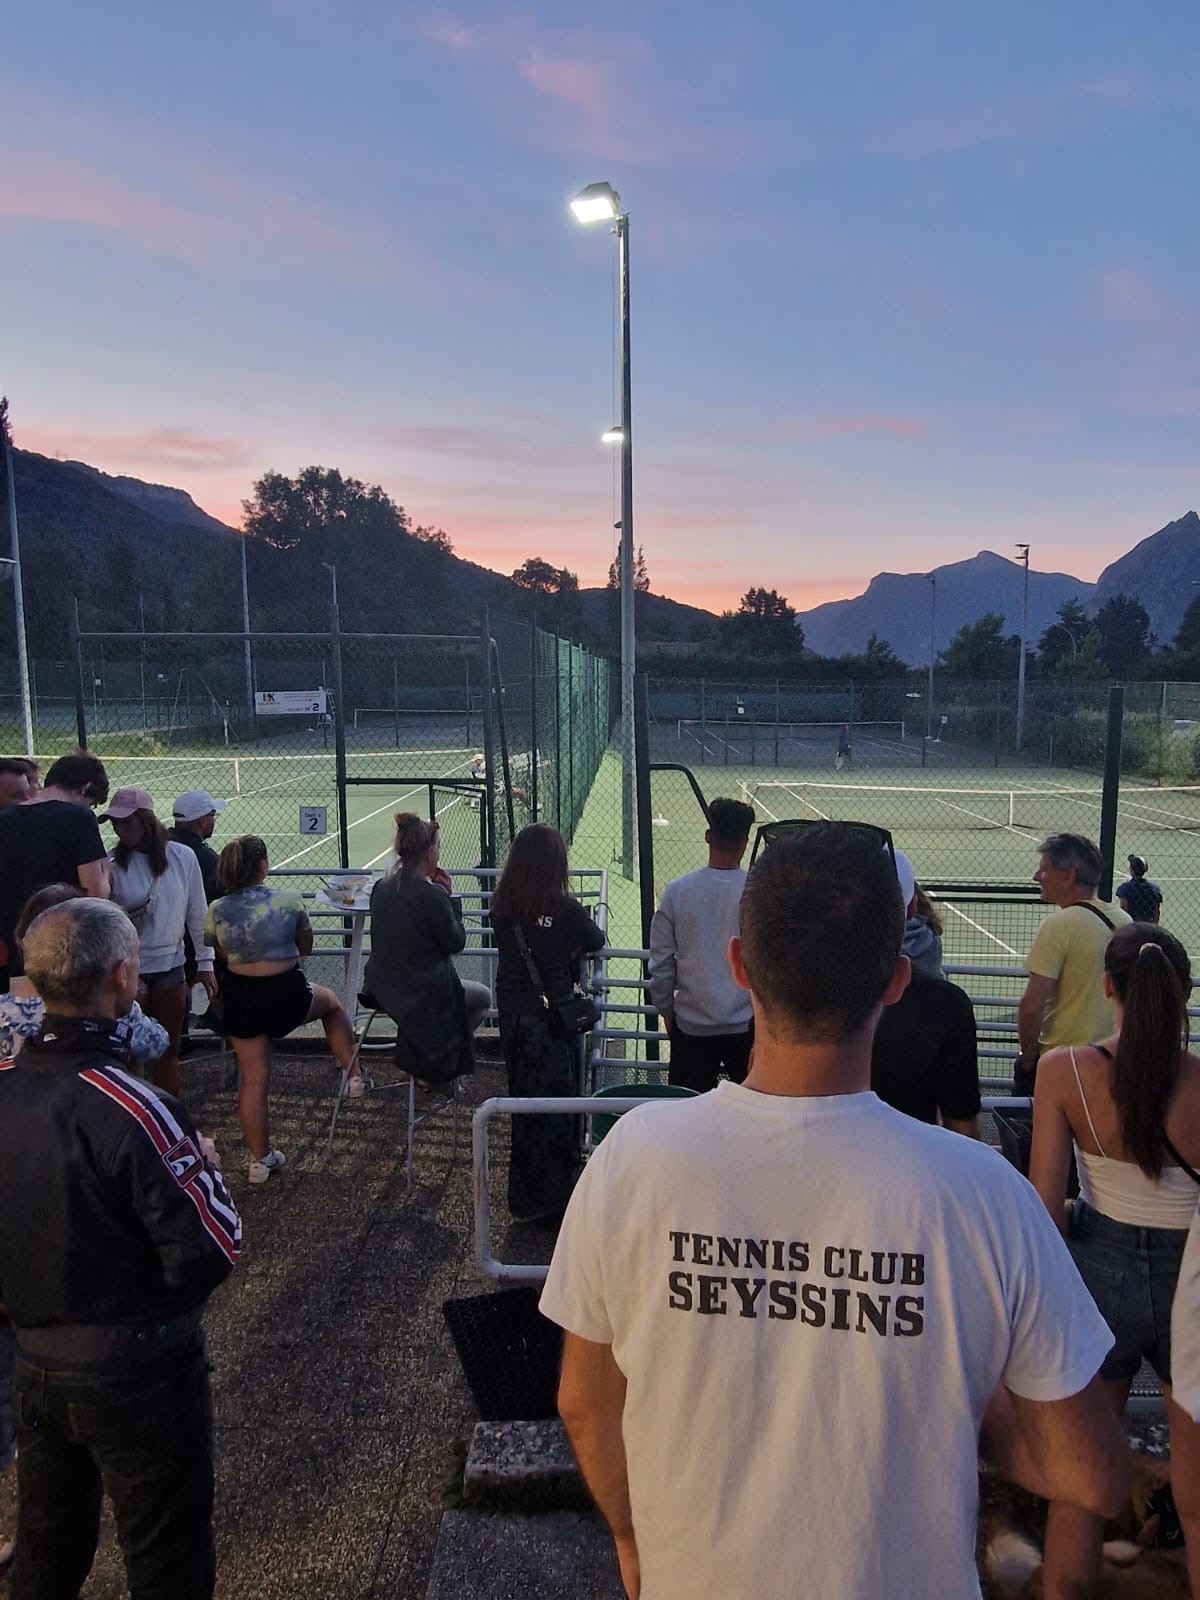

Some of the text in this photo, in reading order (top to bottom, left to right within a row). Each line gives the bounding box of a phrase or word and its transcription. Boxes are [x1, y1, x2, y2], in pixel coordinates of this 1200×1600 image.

[312, 703, 319, 712] 2
[309, 817, 318, 830] 2
[669, 1231, 925, 1285] TENNIS CLUB
[668, 1271, 925, 1337] SEYSSINS
